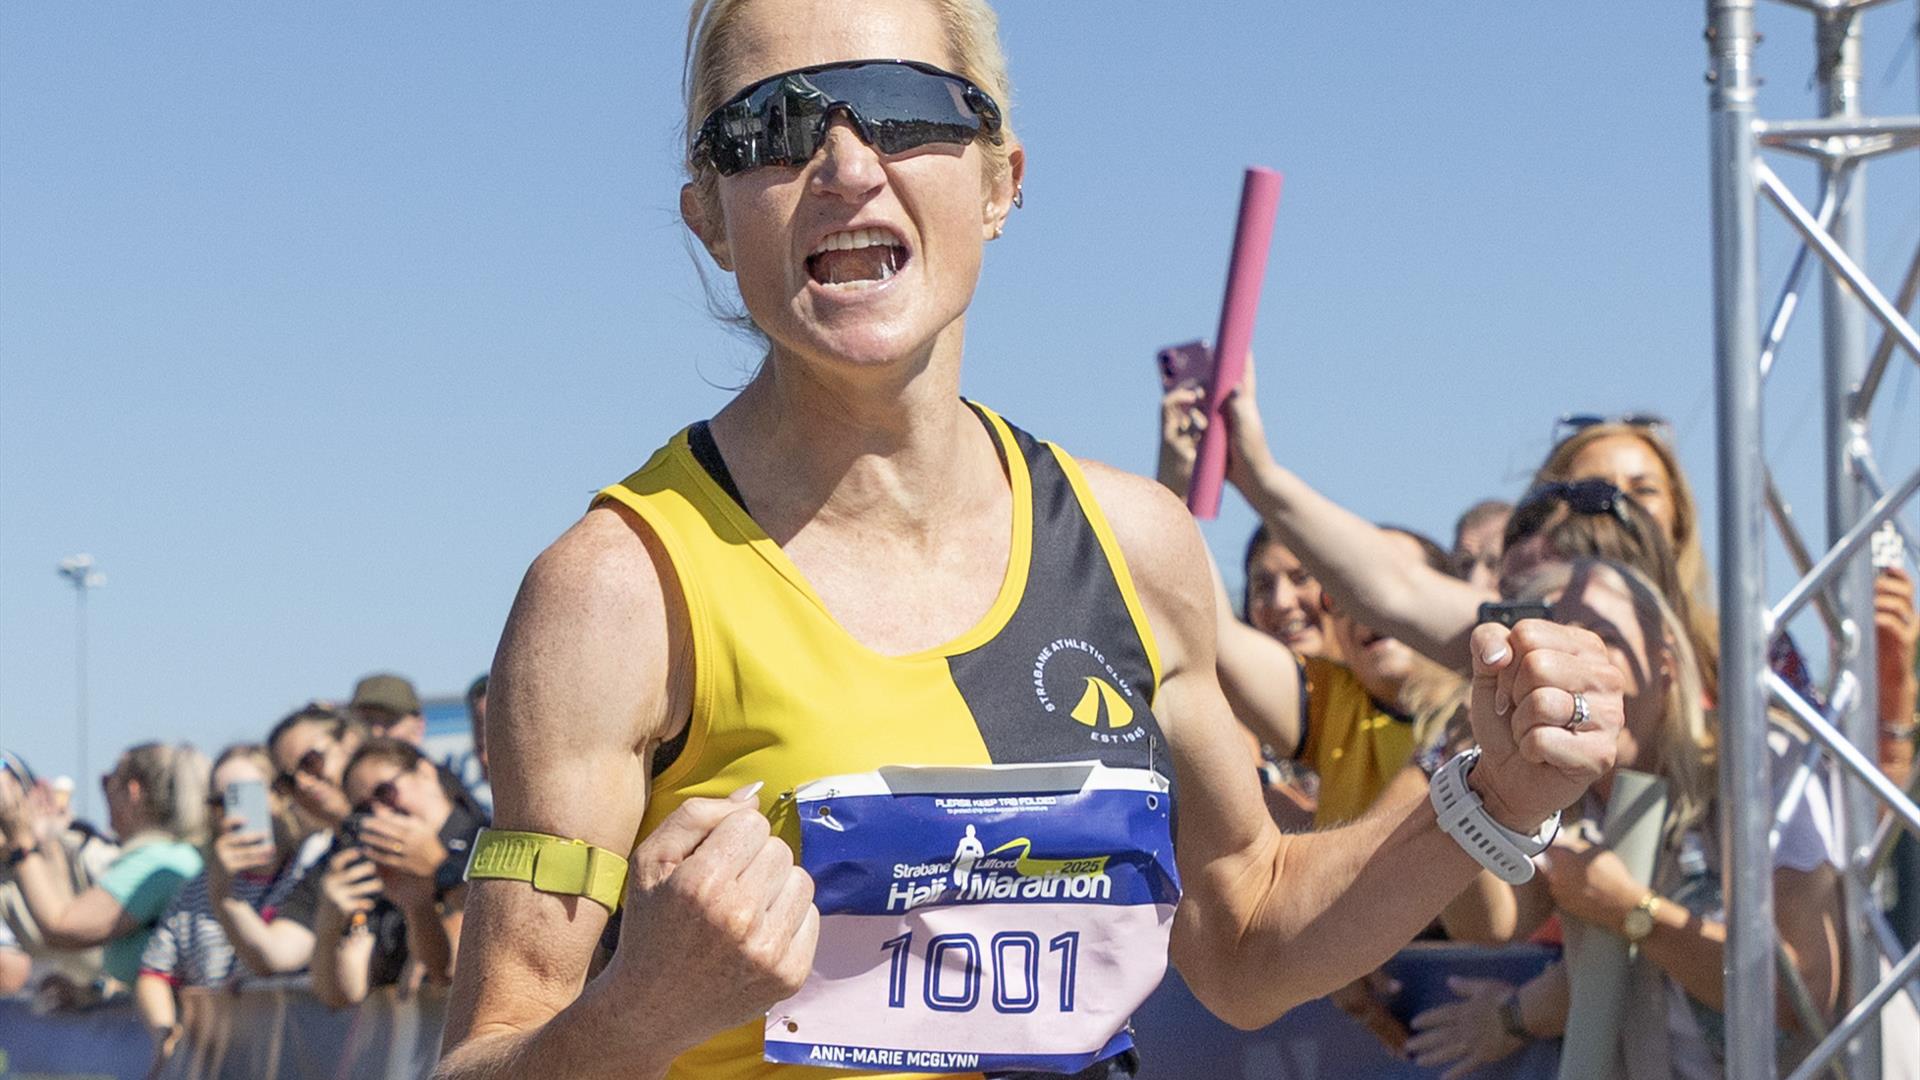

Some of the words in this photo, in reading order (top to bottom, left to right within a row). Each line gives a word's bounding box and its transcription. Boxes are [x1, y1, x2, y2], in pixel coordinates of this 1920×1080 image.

[1033, 647, 1055, 712] STRABANE
[1051, 638, 1105, 664] ATHLETIC
[1090, 732, 1118, 743] EST
[1122, 726, 1145, 742] 1945
[935, 798, 972, 808] PLEASE
[972, 798, 998, 808] KEEP
[1018, 796, 1057, 806] FOLDED
[893, 862, 951, 879] Strabane
[975, 858, 1019, 870] Lifford
[1061, 861, 1100, 874] 2025
[887, 877, 947, 911] Half
[967, 870, 1111, 900] Marathon
[880, 931, 1080, 1014] 1001
[810, 1045, 903, 1065] ANN-MARIE
[907, 1053, 979, 1068] MCGLYNN
